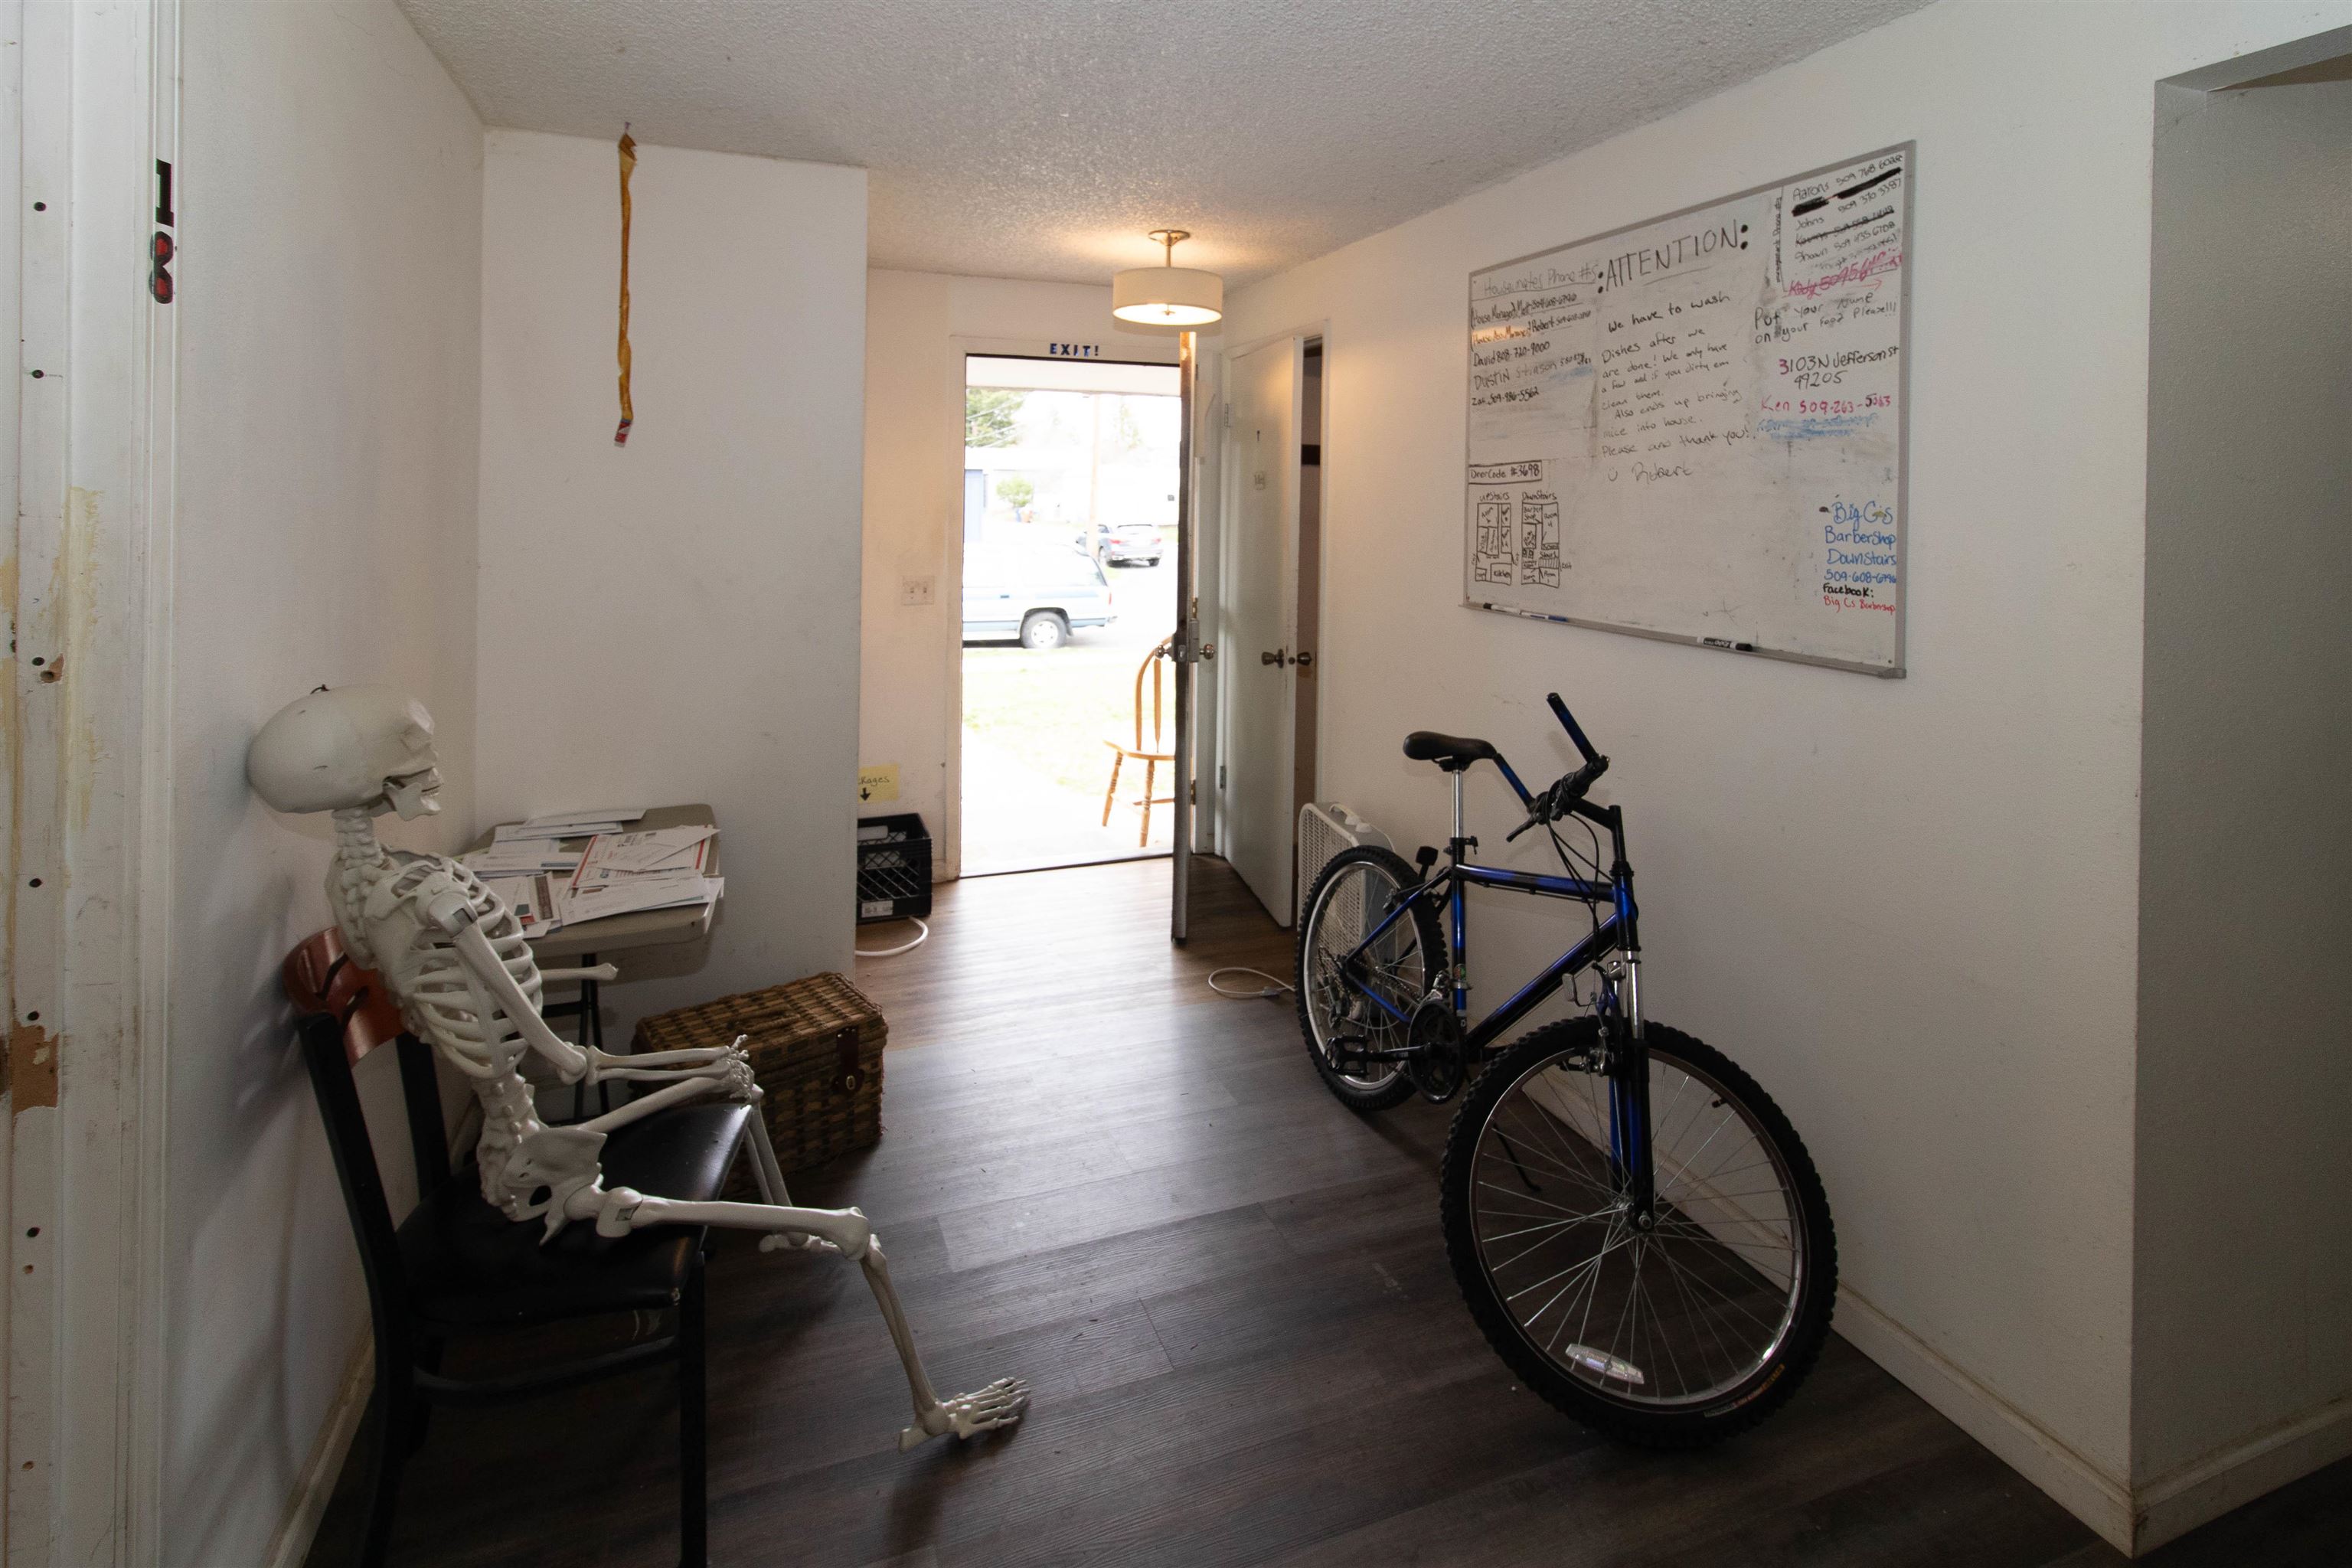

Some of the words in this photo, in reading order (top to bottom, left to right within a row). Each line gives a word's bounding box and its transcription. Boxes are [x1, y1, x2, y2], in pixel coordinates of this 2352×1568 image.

[1609, 320, 1624, 333] We
[1632, 311, 1663, 325] have
[1668, 302, 1682, 315] to
[1690, 291, 1730, 308] wash
[1755, 332, 1771, 345] on
[1050, 343, 1099, 357] EXIT!
[1601, 343, 1641, 364] Dishes
[1602, 368, 1620, 379] are
[1601, 444, 1638, 459] Please
[1678, 430, 1717, 446] thank
[1831, 501, 1861, 532] Big
[1824, 595, 1841, 612] Big
